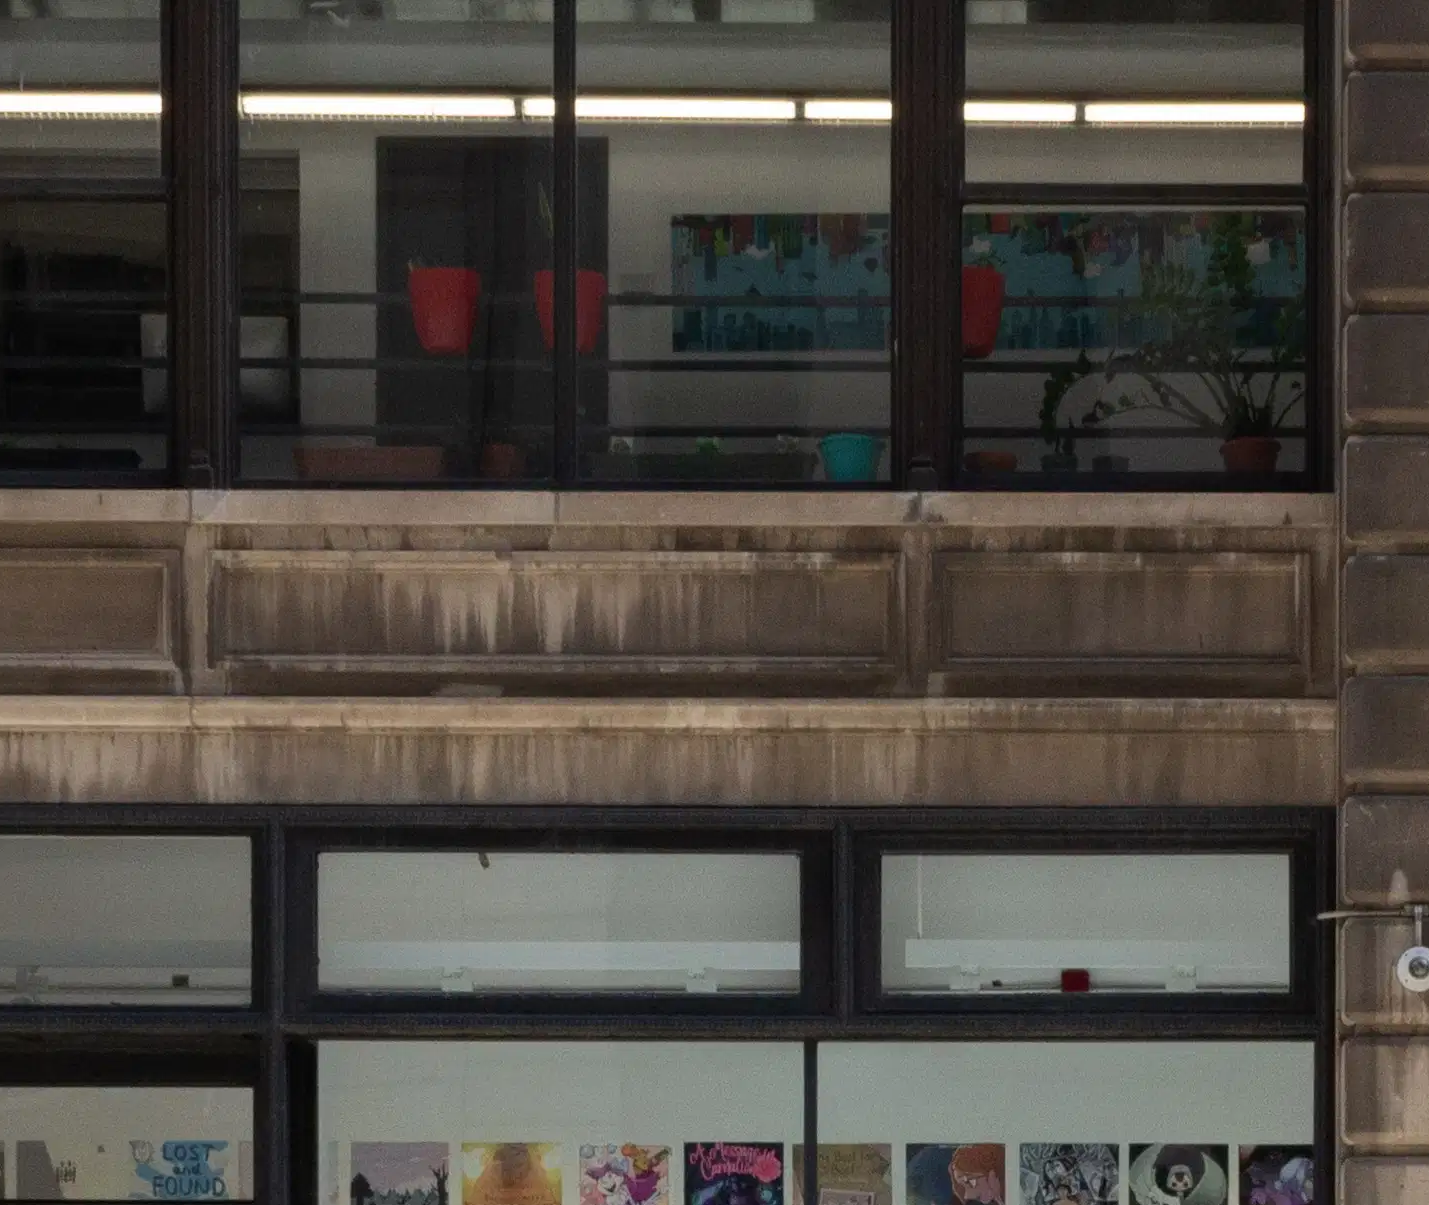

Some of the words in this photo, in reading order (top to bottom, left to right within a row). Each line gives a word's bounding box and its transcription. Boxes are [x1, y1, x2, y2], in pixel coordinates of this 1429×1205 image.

[162, 1143, 210, 1161] LOST
[172, 1163, 201, 1175] and
[152, 1176, 226, 1197] FOUND
